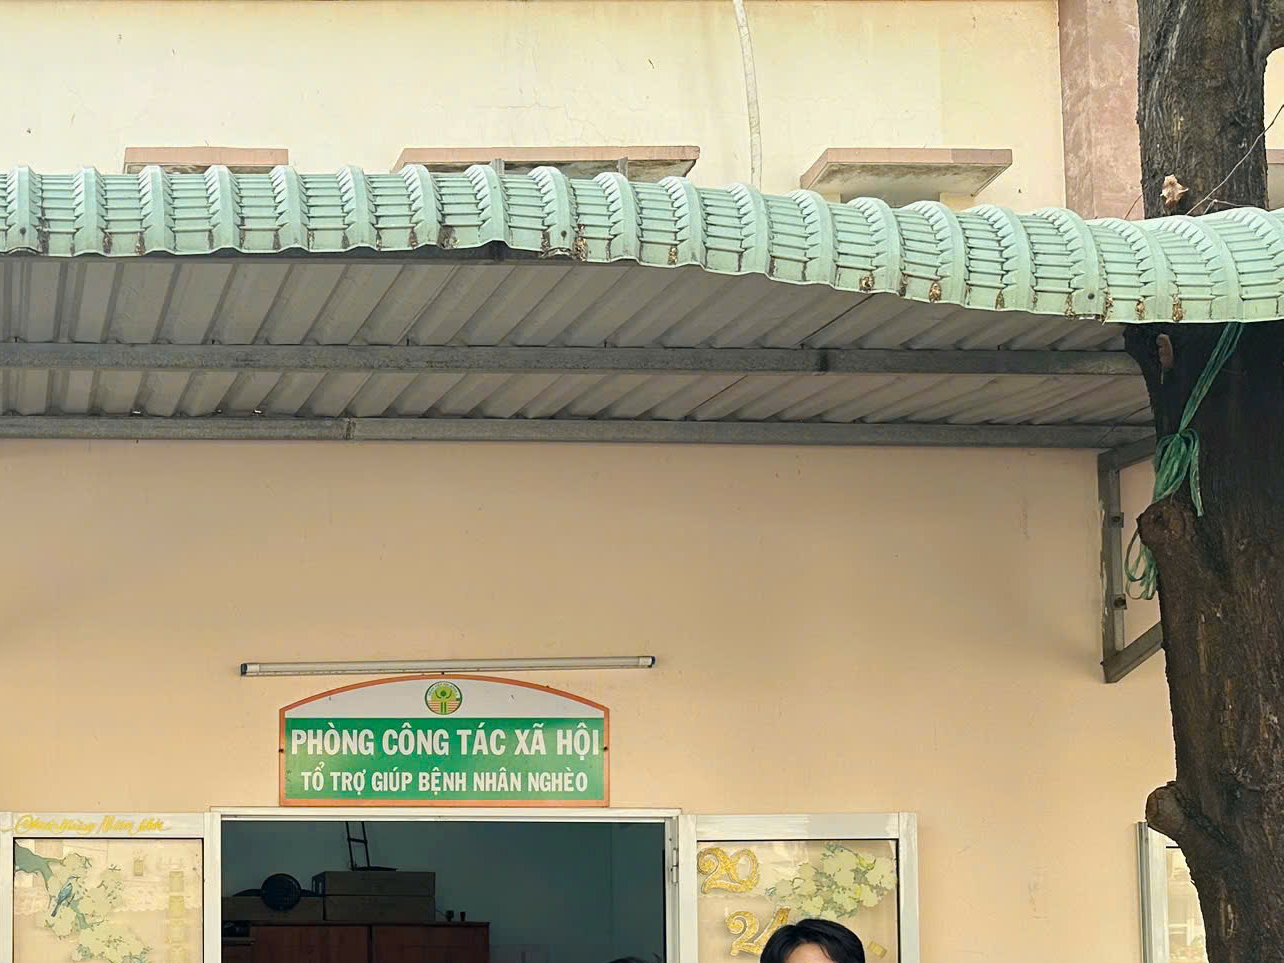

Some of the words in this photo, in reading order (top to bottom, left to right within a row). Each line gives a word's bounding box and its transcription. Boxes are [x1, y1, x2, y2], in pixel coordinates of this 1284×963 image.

[291, 722, 374, 755] PHÒNG
[382, 722, 449, 756] CÔNG
[456, 722, 506, 756] TÁC
[514, 722, 547, 755] XÃ
[557, 722, 599, 760] HỘI
[301, 761, 325, 791] TỔ
[330, 768, 366, 795] TRỢ
[371, 767, 413, 792] GIÚP
[418, 767, 467, 795] BỆNH
[473, 767, 522, 792] NHÂN
[528, 767, 588, 792] NGHÈO
[697, 848, 759, 894] 20
